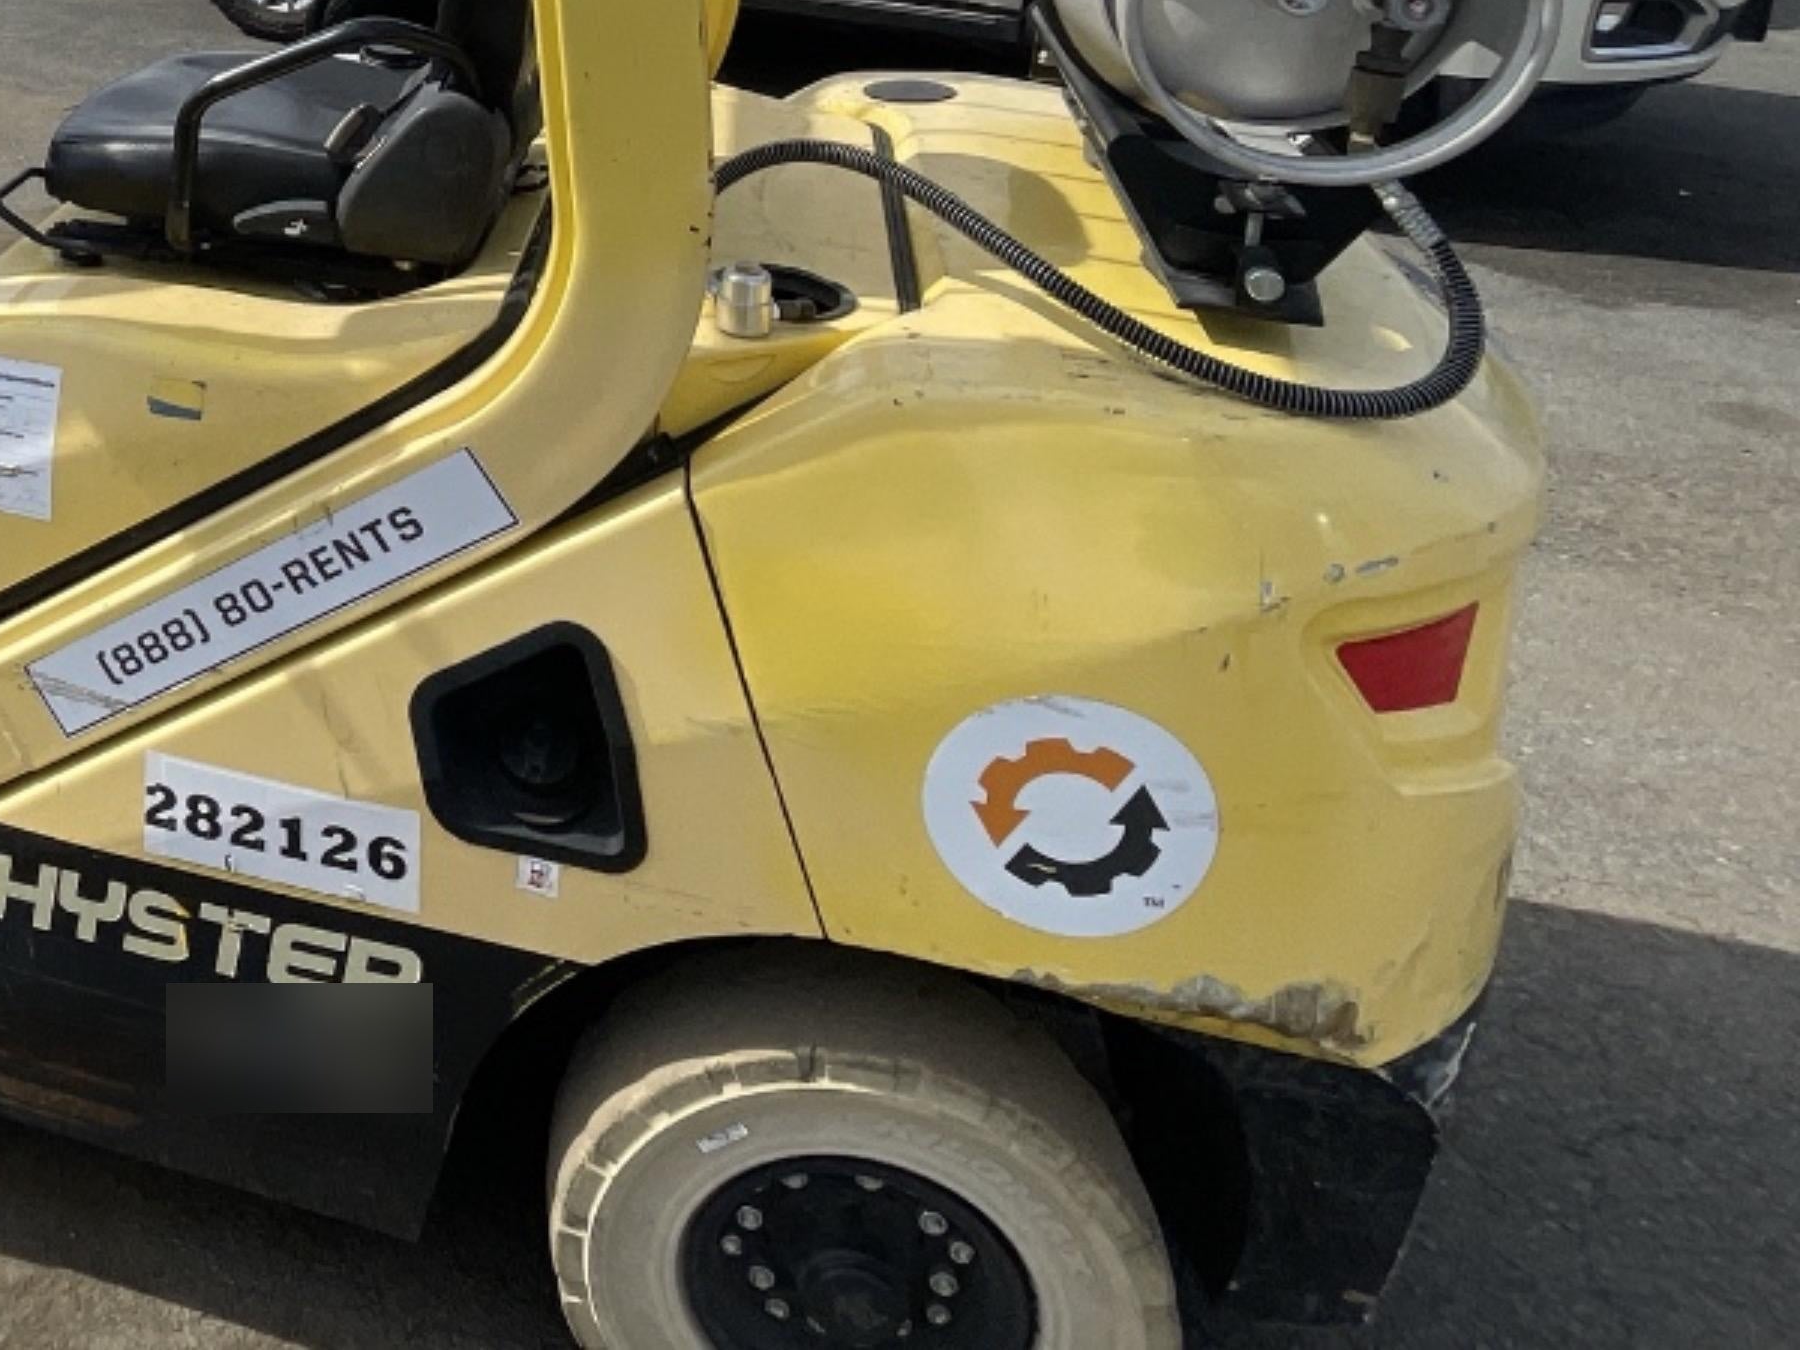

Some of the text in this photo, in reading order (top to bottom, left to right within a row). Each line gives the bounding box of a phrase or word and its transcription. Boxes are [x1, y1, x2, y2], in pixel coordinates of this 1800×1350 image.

[96, 506, 424, 686] (888) 80-RENTS
[145, 782, 408, 881] 282126
